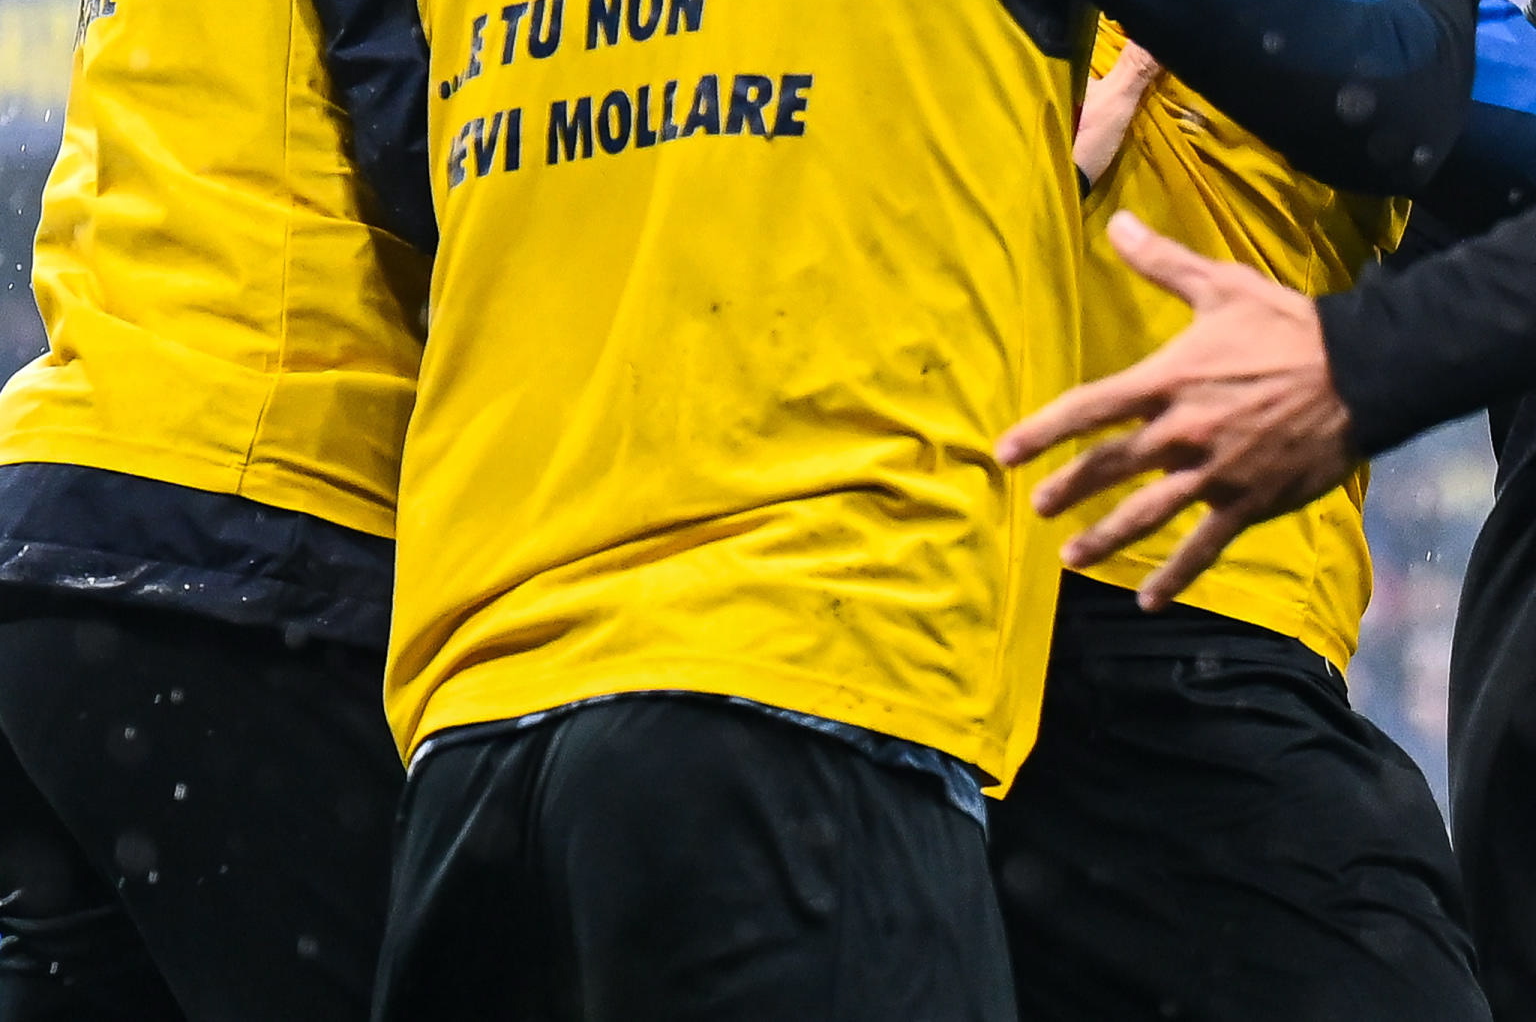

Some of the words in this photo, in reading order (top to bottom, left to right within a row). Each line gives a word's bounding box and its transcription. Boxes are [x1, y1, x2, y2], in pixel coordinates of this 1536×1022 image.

[438, 13, 488, 100] ..E
[448, 107, 522, 191] EVI
[546, 74, 813, 166] MOLLARE
